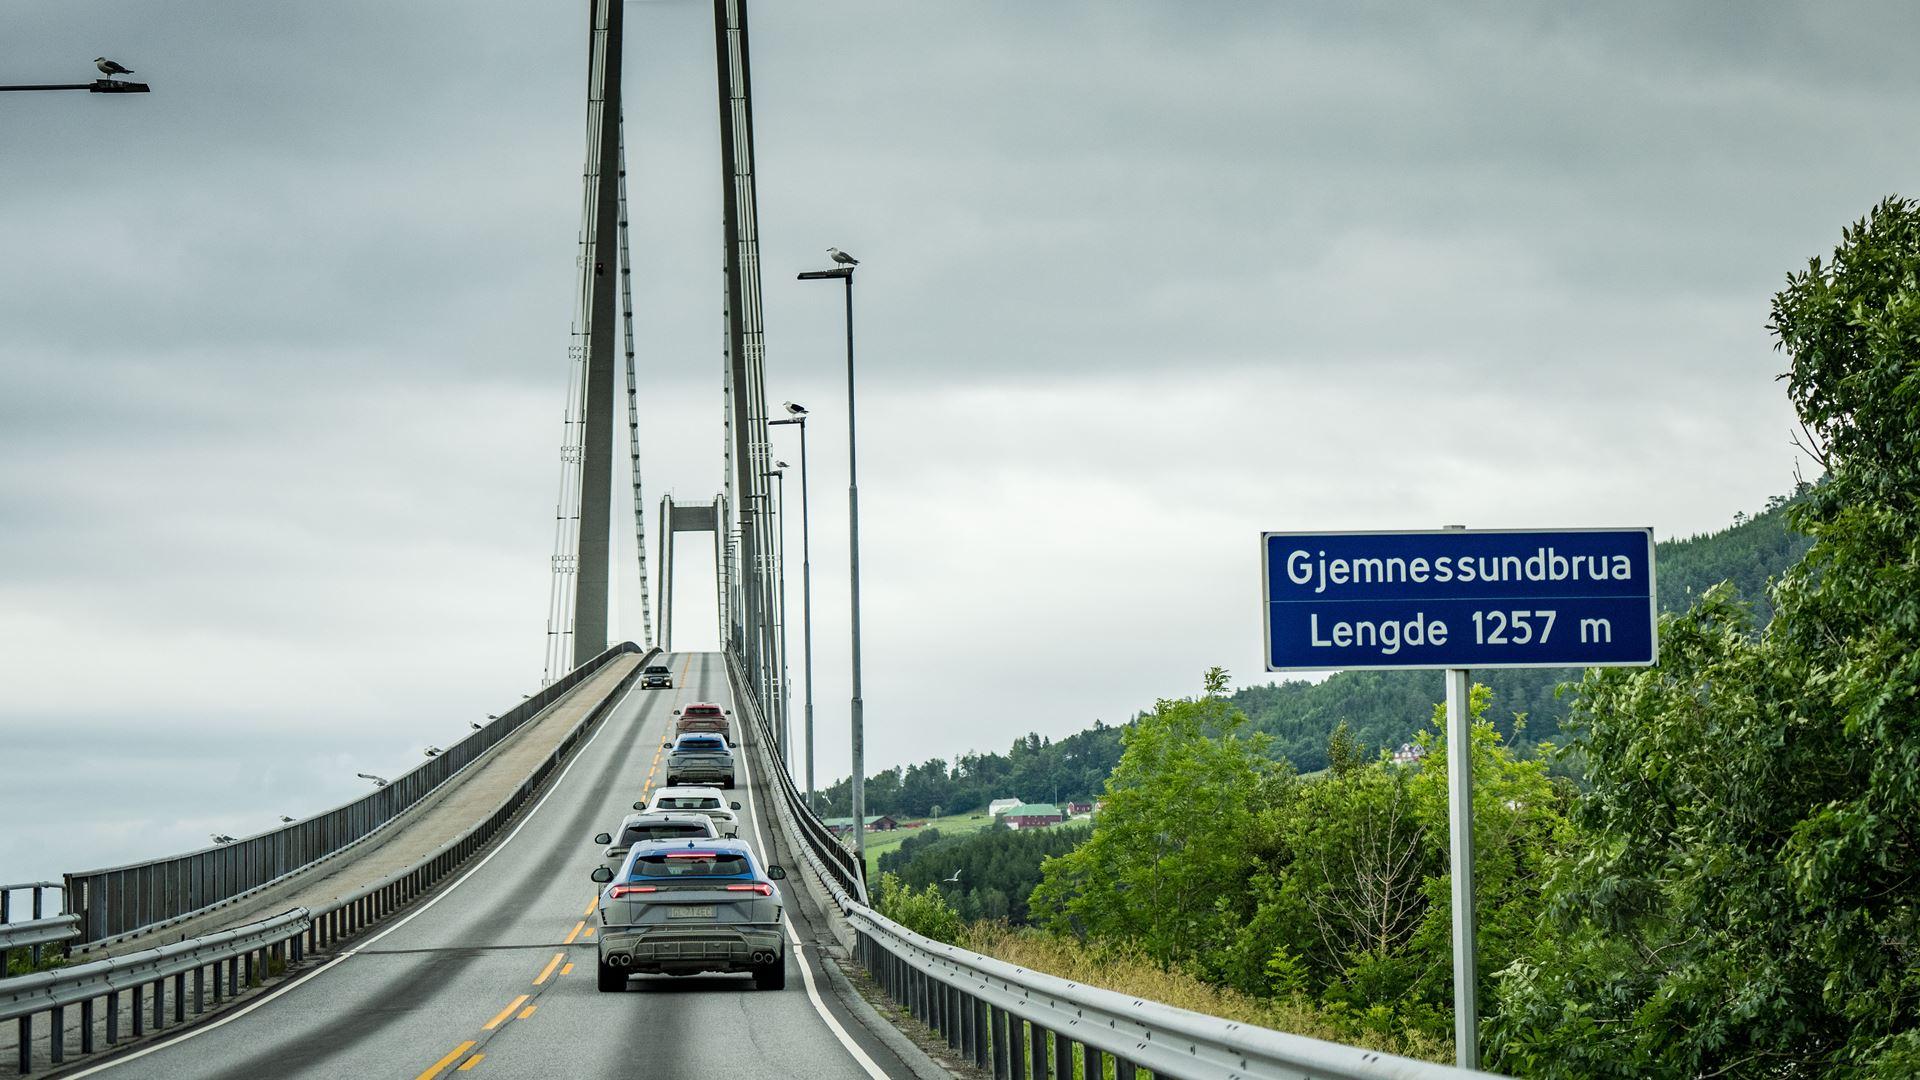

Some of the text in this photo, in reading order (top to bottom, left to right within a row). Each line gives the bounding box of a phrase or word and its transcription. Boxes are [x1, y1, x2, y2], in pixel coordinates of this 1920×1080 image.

[1286, 547, 1632, 594] Gjemnessundbrua
[1310, 610, 1612, 655] Lengde 1257 m
